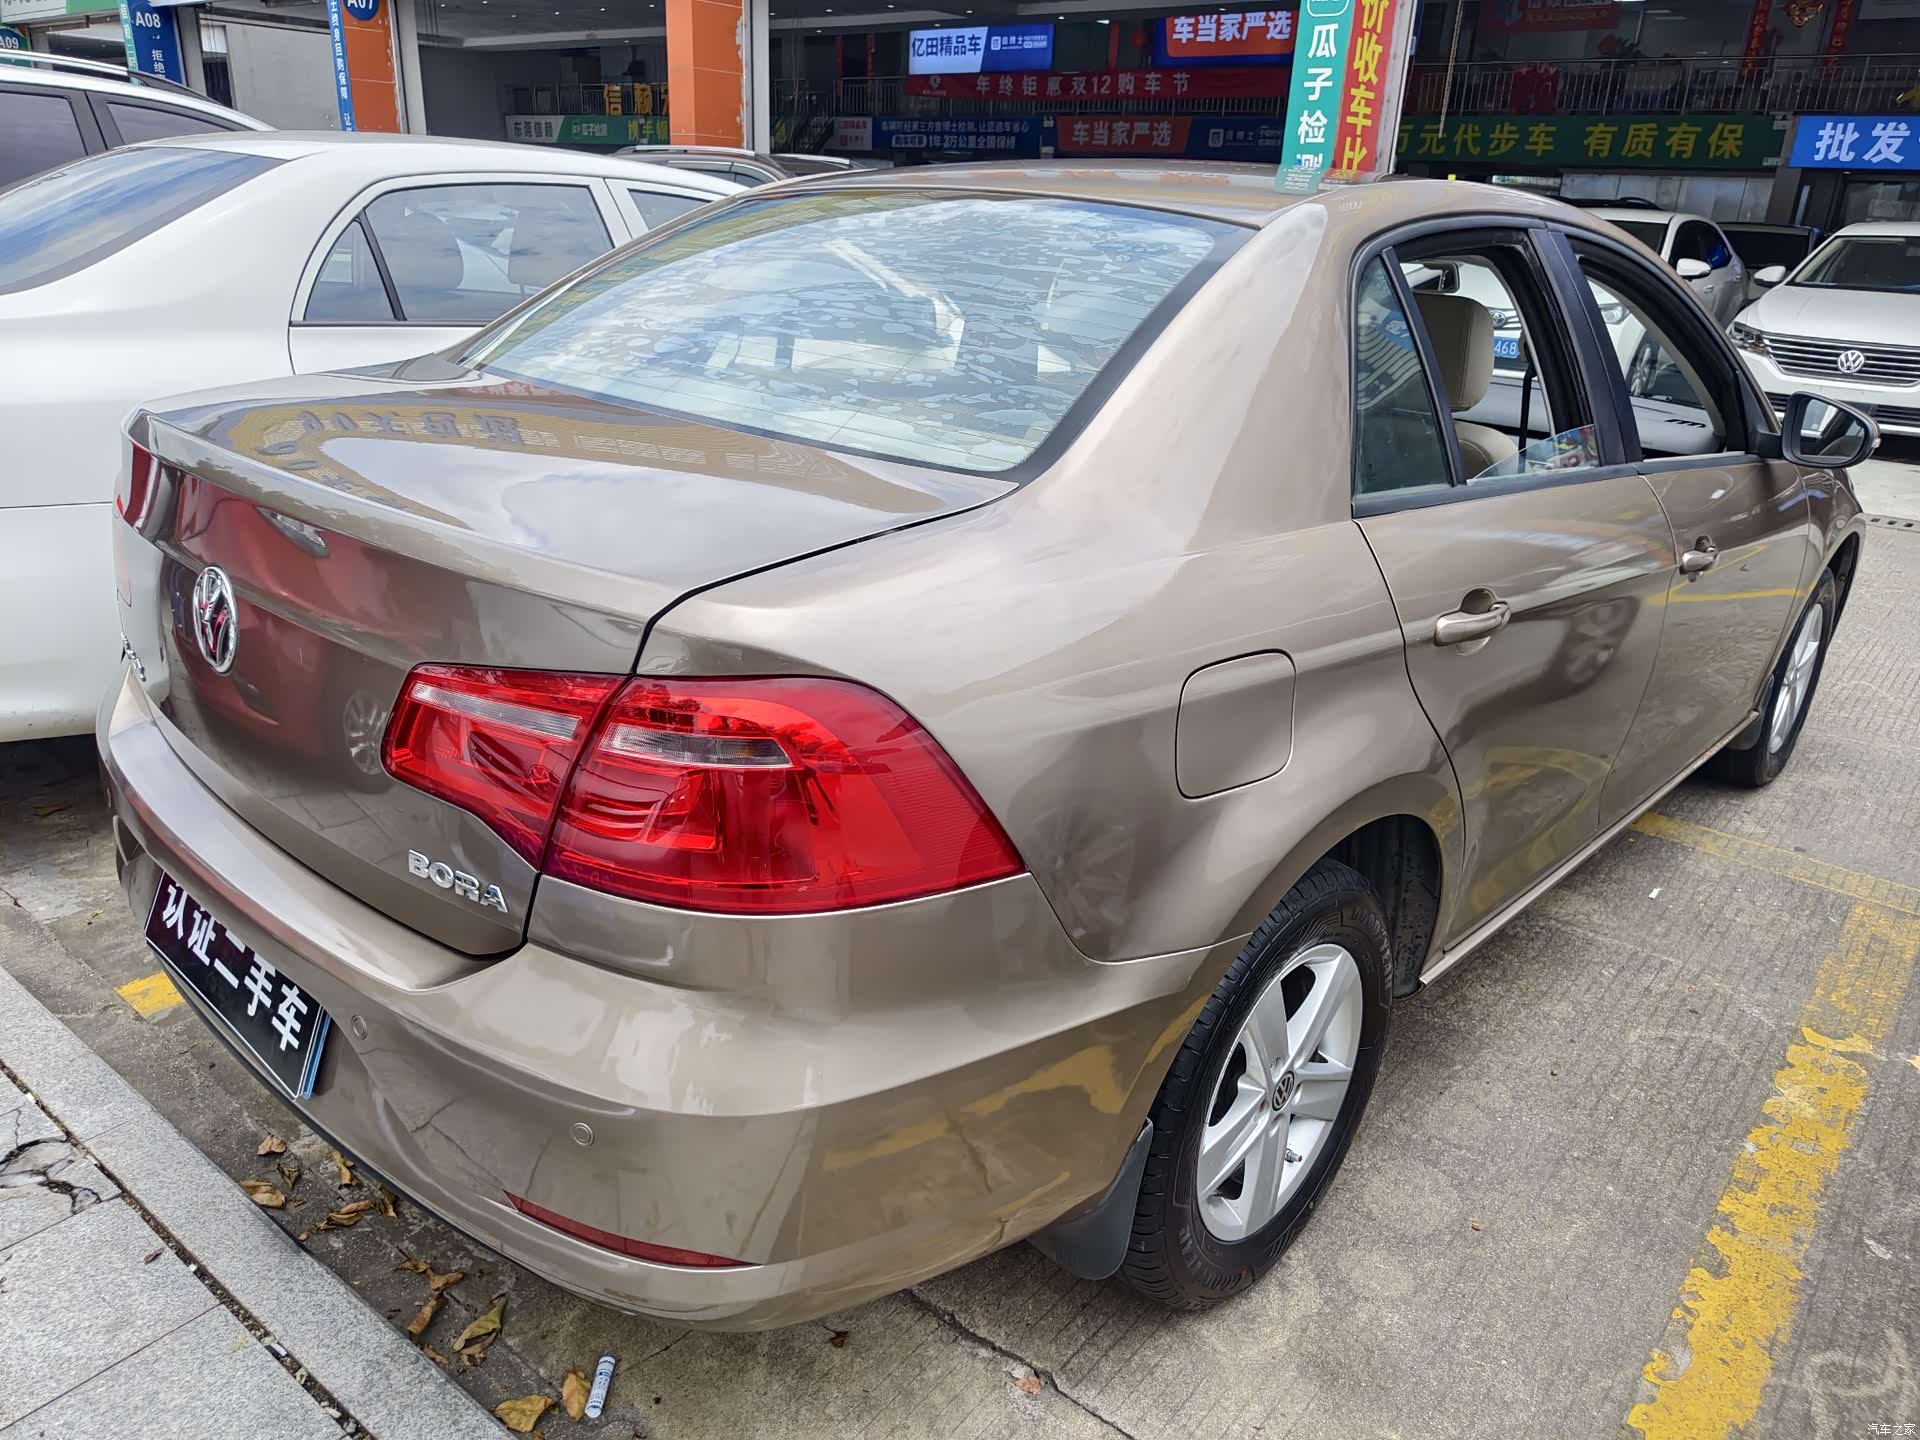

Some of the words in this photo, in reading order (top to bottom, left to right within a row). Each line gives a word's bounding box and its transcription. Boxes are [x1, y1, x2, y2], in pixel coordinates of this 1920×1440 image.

[136, 11, 161, 28] A08
[1172, 10, 1292, 43] 车当家严选
[912, 35, 982, 57] 亿田精品车
[1072, 121, 1172, 147] 车当家严选
[1583, 121, 1744, 165] 有质有保
[1813, 121, 1911, 164] 批发
[408, 849, 508, 913] BORA
[161, 883, 308, 1052] 认证二手车
